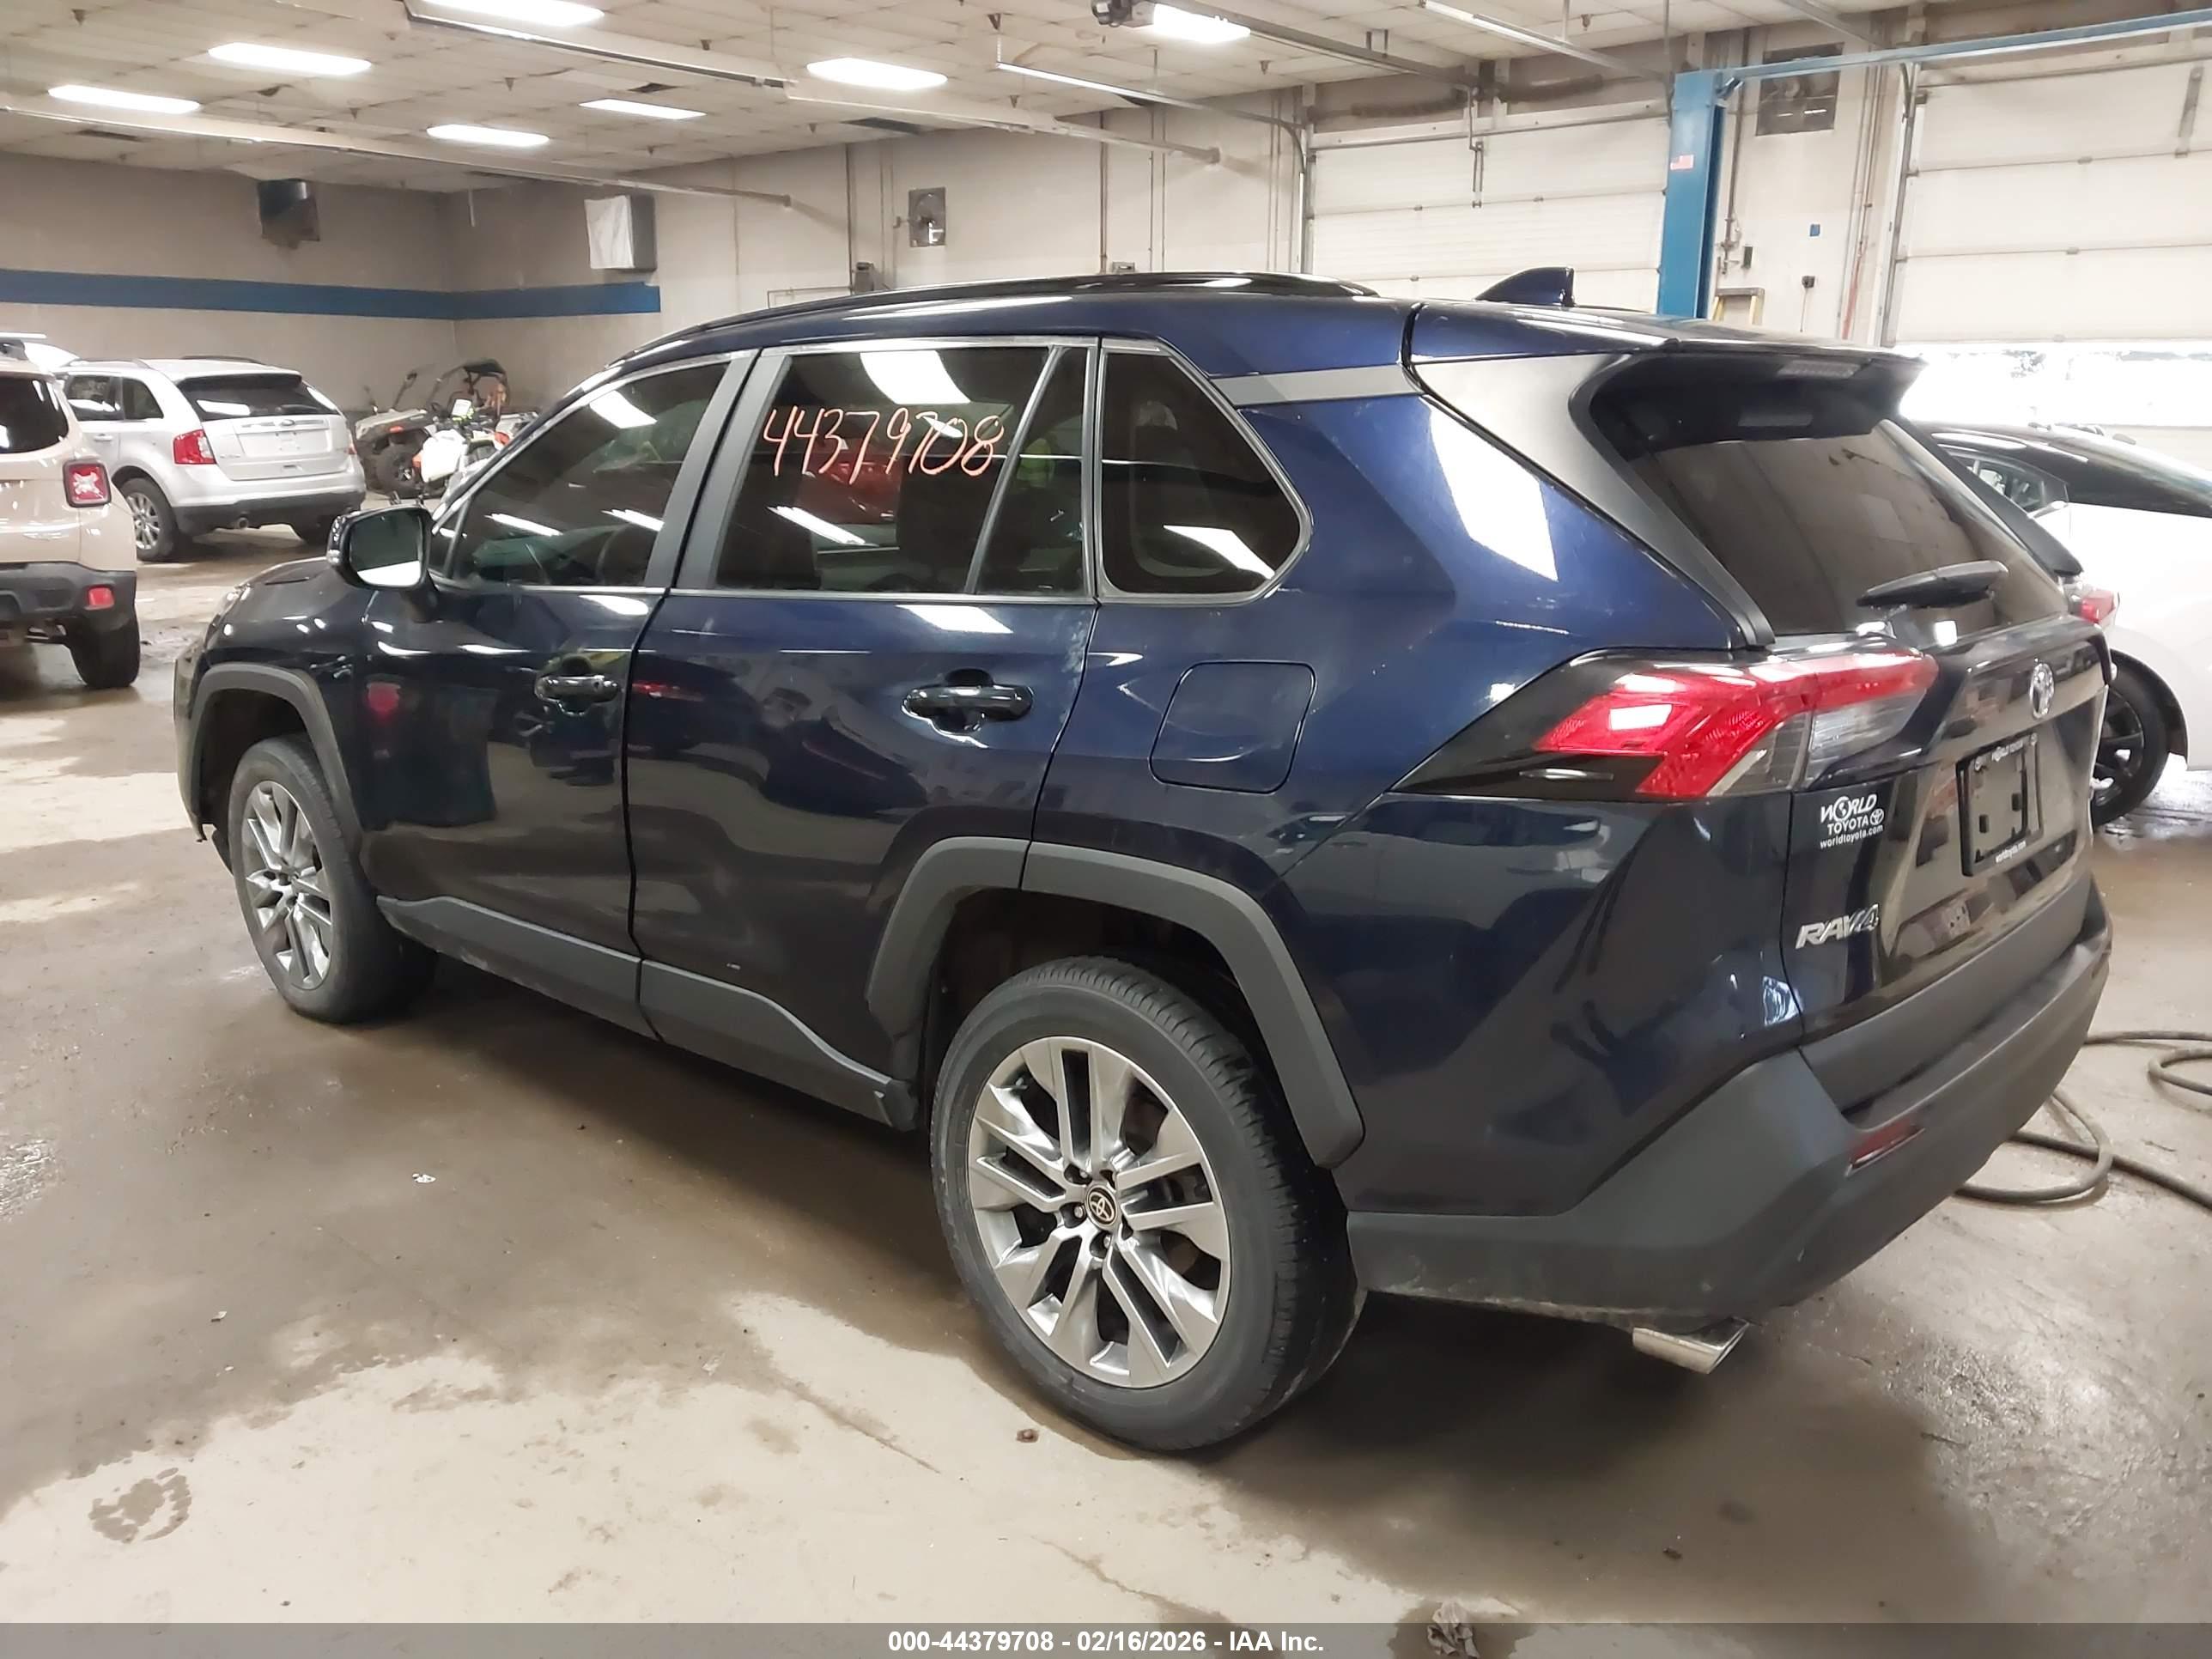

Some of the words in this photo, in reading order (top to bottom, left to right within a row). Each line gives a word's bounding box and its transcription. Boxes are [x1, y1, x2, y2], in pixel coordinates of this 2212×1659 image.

[763, 405, 1004, 484] 44379708
[1820, 793, 1878, 823] WORLD
[1820, 824, 1883, 849] worldtoyota.com
[1827, 815, 1869, 836] TOYOTA
[1795, 903, 1879, 949] RAV4
